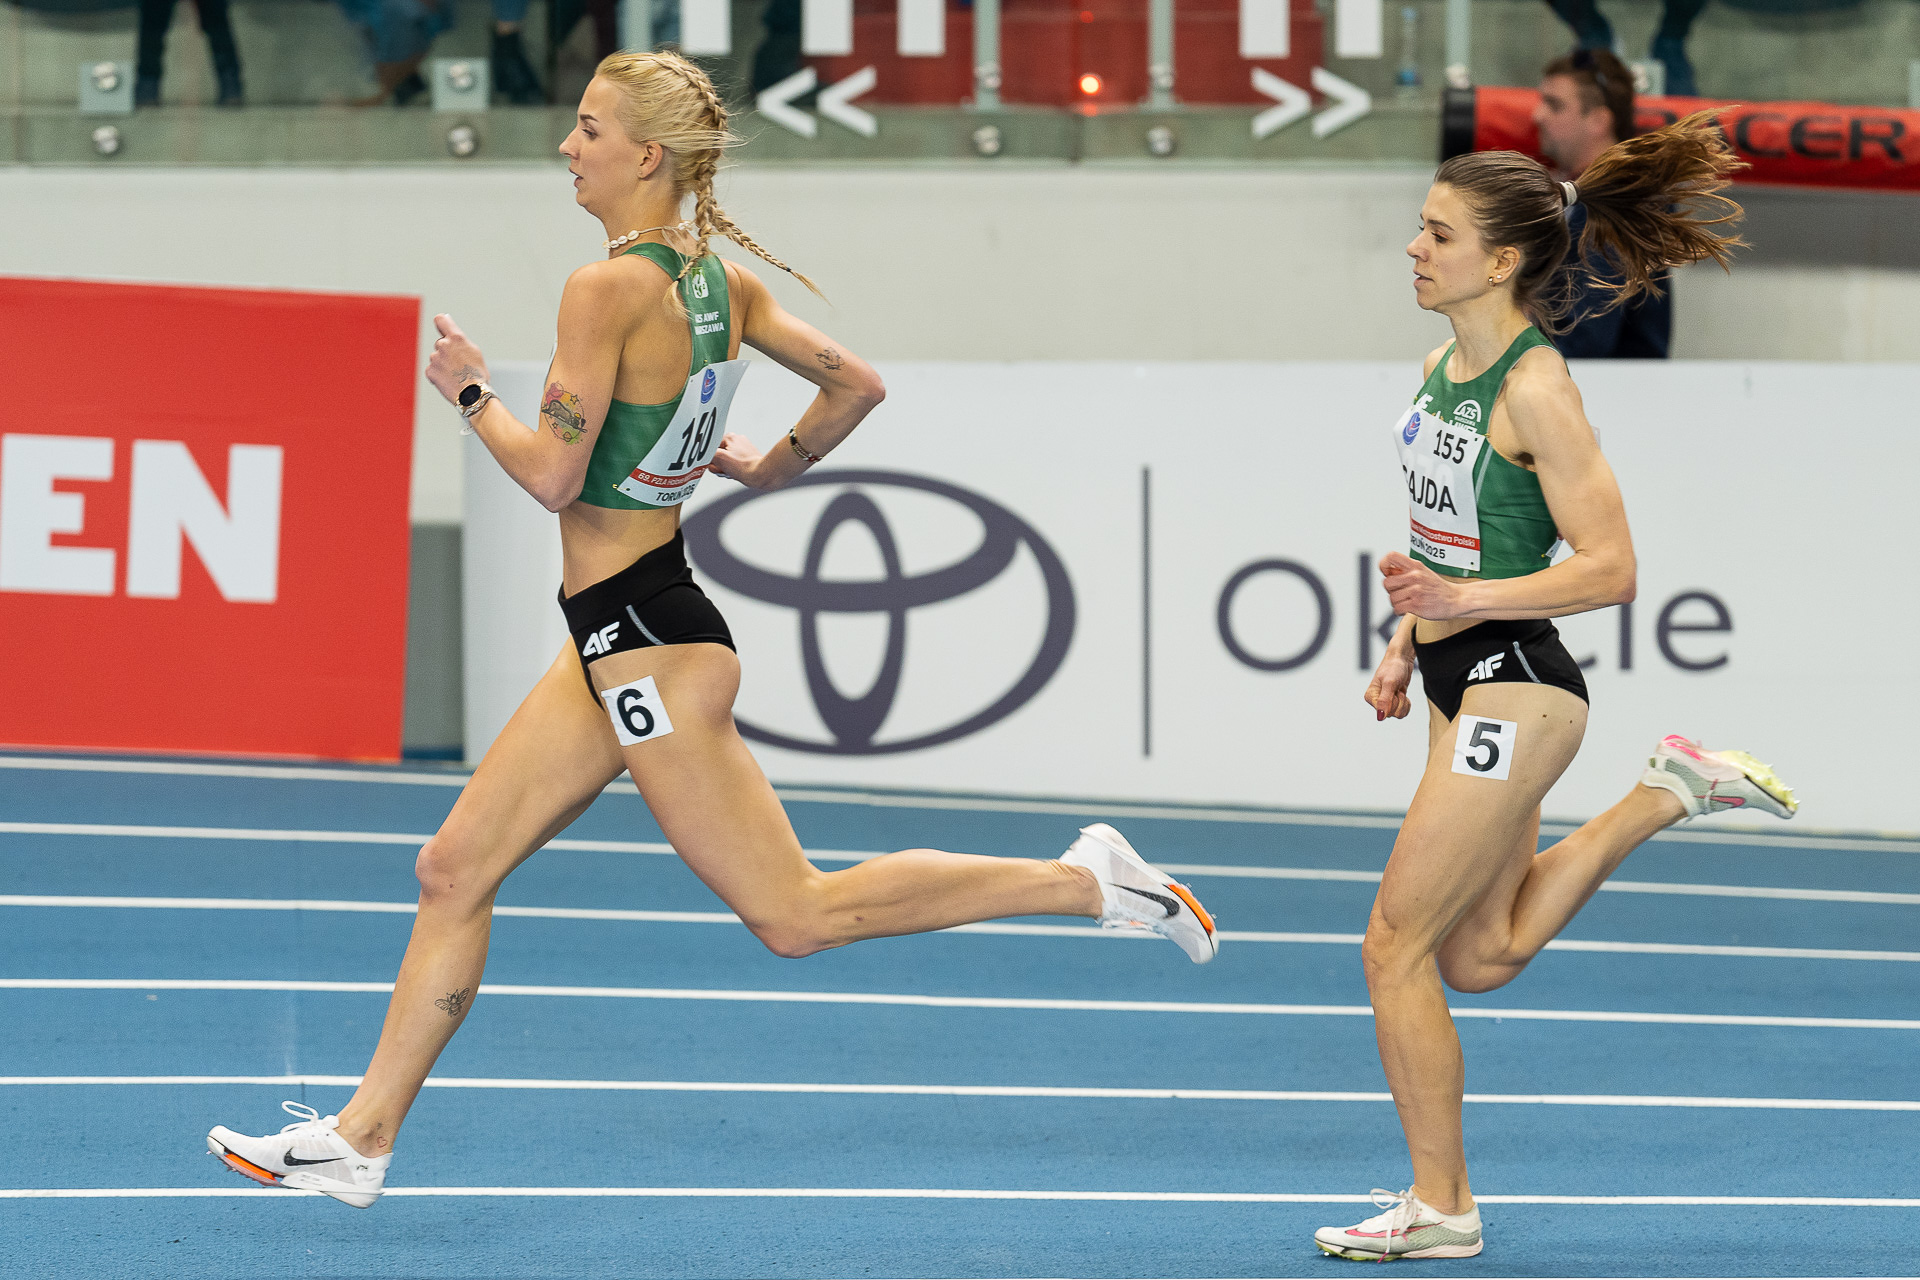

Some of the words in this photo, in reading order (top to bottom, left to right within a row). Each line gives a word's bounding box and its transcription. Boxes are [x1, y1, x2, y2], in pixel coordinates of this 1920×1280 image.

[1458, 405, 1478, 419] AZS
[668, 406, 717, 471] 160
[1433, 429, 1469, 464] 155
[0, 433, 284, 604] EN
[1425, 543, 1446, 559] 2025
[1454, 536, 1475, 547] Polski
[1217, 552, 1734, 673] Okie
[582, 621, 620, 657] 4F
[1467, 652, 1505, 681] 4F
[617, 688, 655, 737] 6
[1466, 721, 1502, 772] 5
